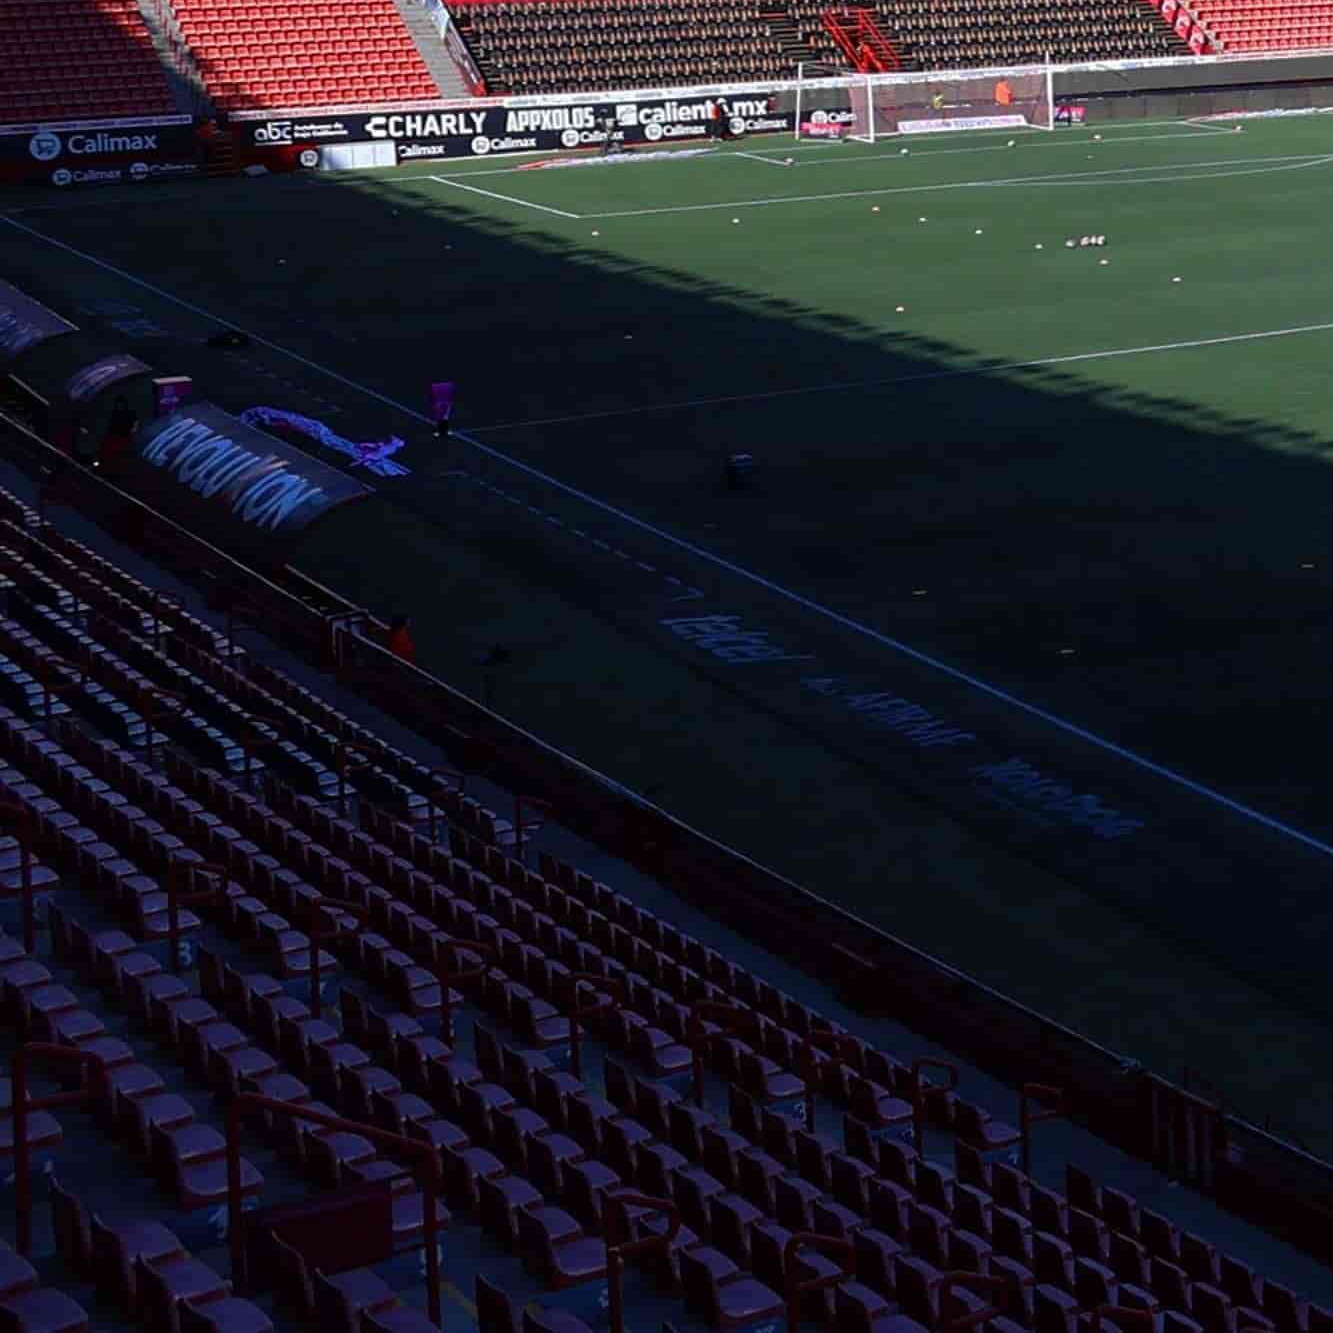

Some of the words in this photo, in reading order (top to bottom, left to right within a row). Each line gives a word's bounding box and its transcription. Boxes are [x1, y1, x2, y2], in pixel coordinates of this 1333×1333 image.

[388, 112, 487, 137] CHARLY
[506, 106, 595, 133] APPXOLOS
[254, 121, 292, 140] abc
[67, 133, 158, 154] Calimax
[491, 137, 537, 150] Calimax
